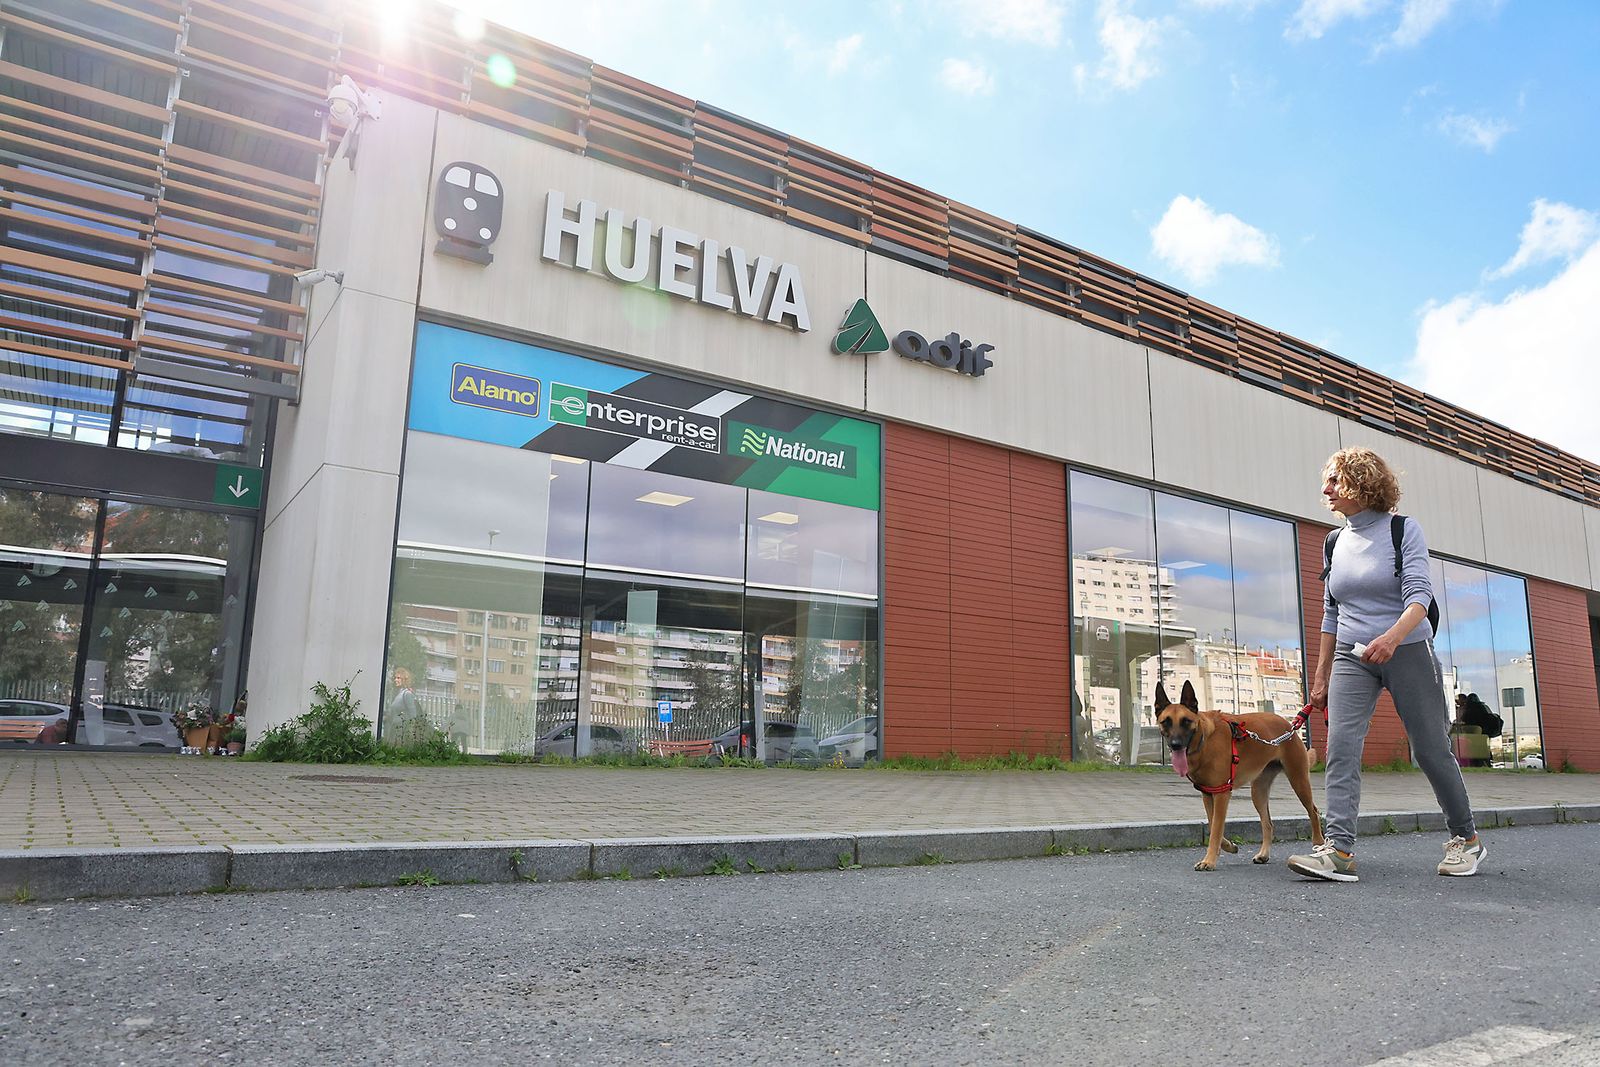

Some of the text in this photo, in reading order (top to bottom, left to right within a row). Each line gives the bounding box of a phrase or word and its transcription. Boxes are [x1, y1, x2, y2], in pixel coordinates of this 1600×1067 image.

[541, 191, 811, 333] HUELVA
[892, 330, 995, 377] adif
[458, 376, 535, 406] Alamo
[560, 396, 718, 441] enterprise
[661, 433, 716, 450] rent-a-car
